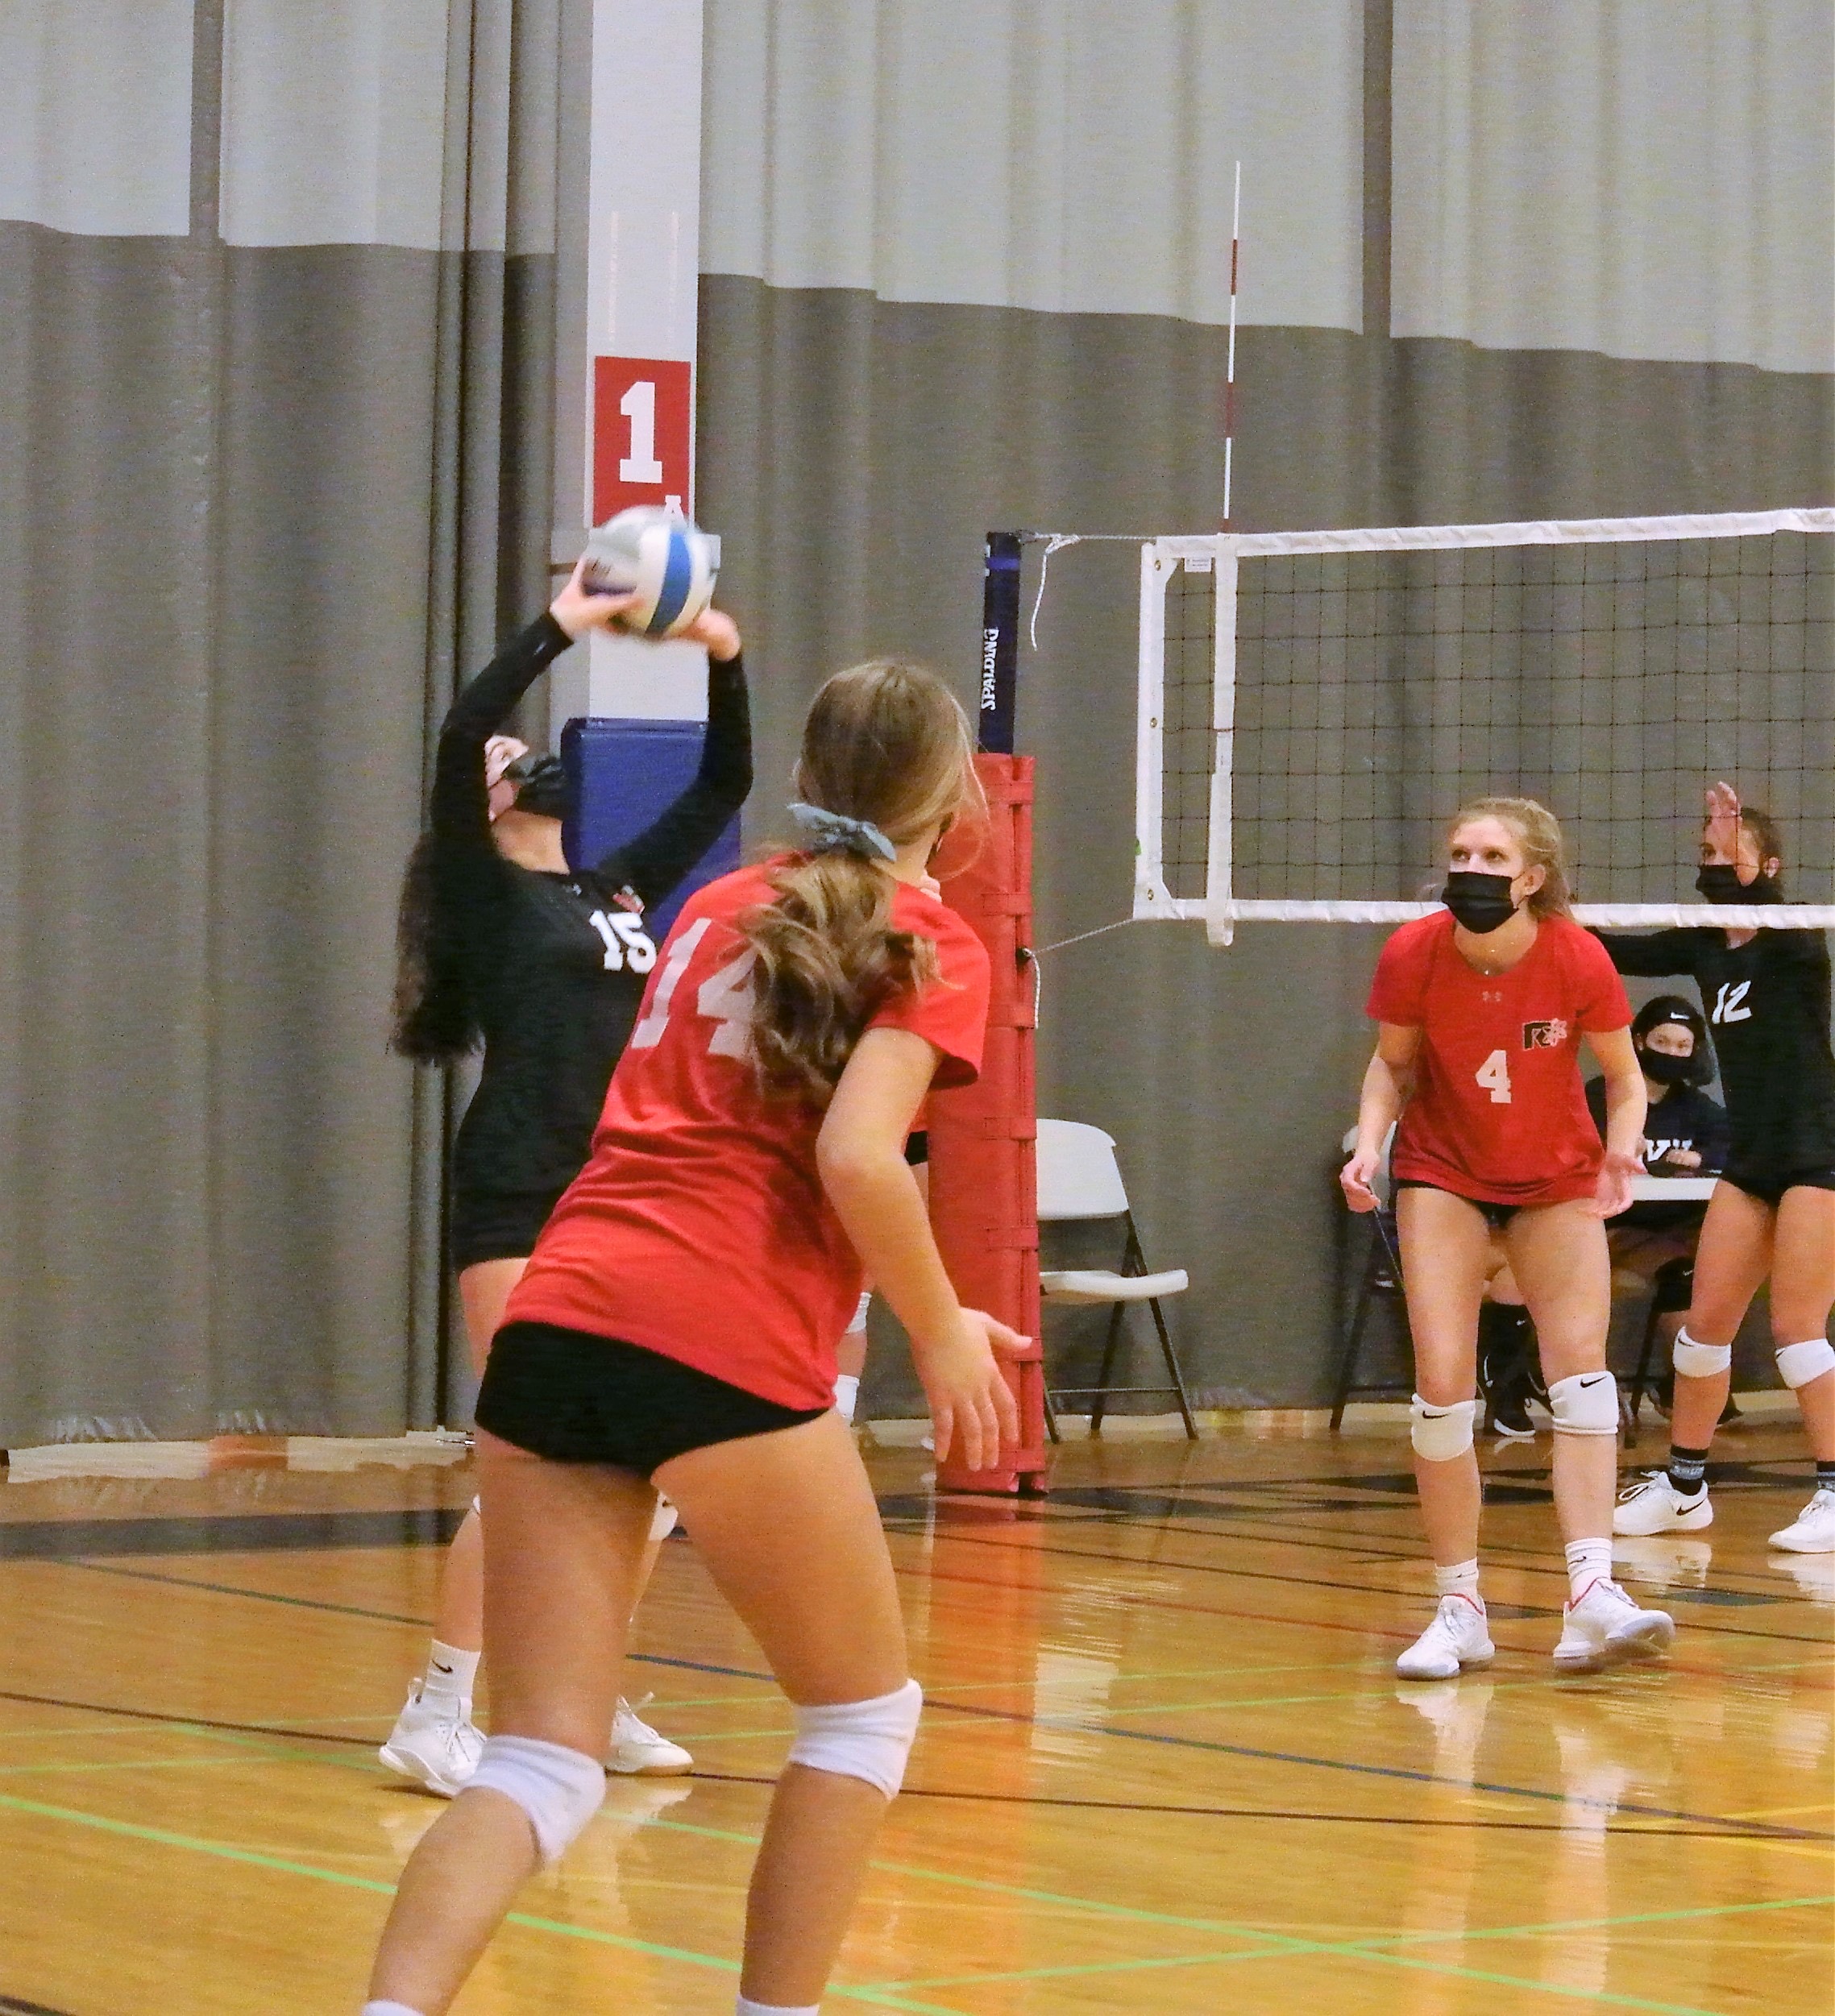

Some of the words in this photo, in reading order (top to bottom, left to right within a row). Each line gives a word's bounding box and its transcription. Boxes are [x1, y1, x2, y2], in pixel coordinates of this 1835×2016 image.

[619, 380, 663, 484] 1
[981, 627, 999, 711] SPALDING
[589, 909, 657, 974] 15
[631, 917, 758, 1062] 14
[1712, 980, 1753, 1025] 12
[1475, 1049, 1512, 1104] 4
